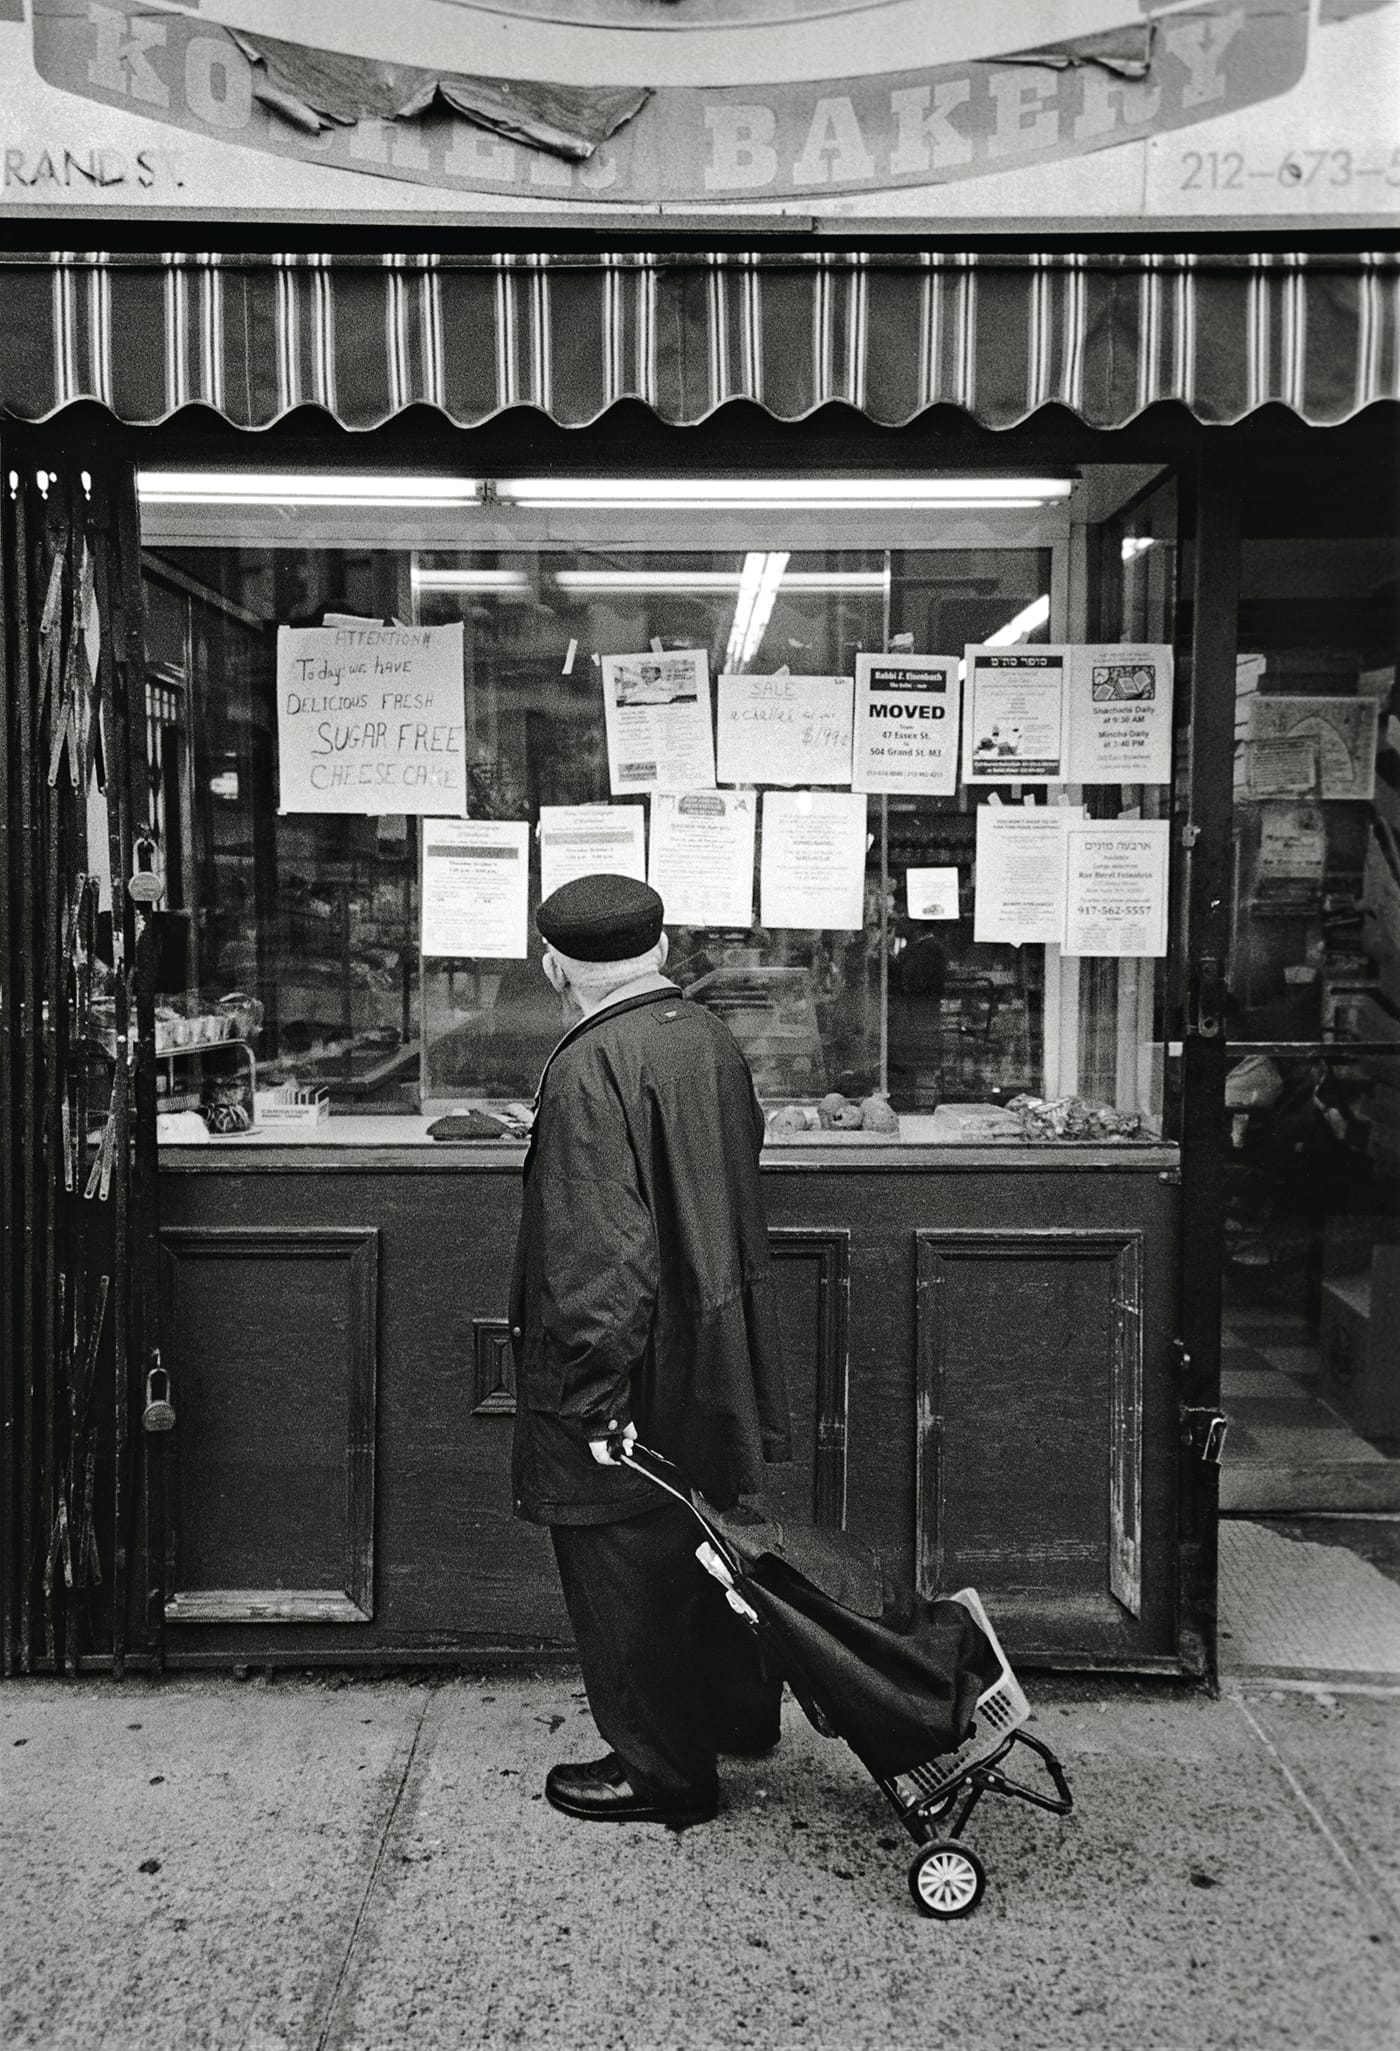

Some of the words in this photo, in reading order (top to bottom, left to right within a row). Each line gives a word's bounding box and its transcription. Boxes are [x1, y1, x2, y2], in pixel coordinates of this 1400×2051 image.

[703, 9, 1246, 192] BAKERY
[749, 681, 797, 696] SALE
[286, 692, 368, 715] DELICIOUS
[381, 692, 433, 710] FRESH
[868, 704, 946, 719] MOVED
[1132, 715, 1145, 723] AM
[311, 721, 388, 755] SUGAR
[398, 723, 463, 753] FREE
[1131, 739, 1145, 747] PM
[870, 748, 885, 756] 504
[887, 748, 913, 756] Grand
[1077, 905, 1152, 916] 917-562-5557
